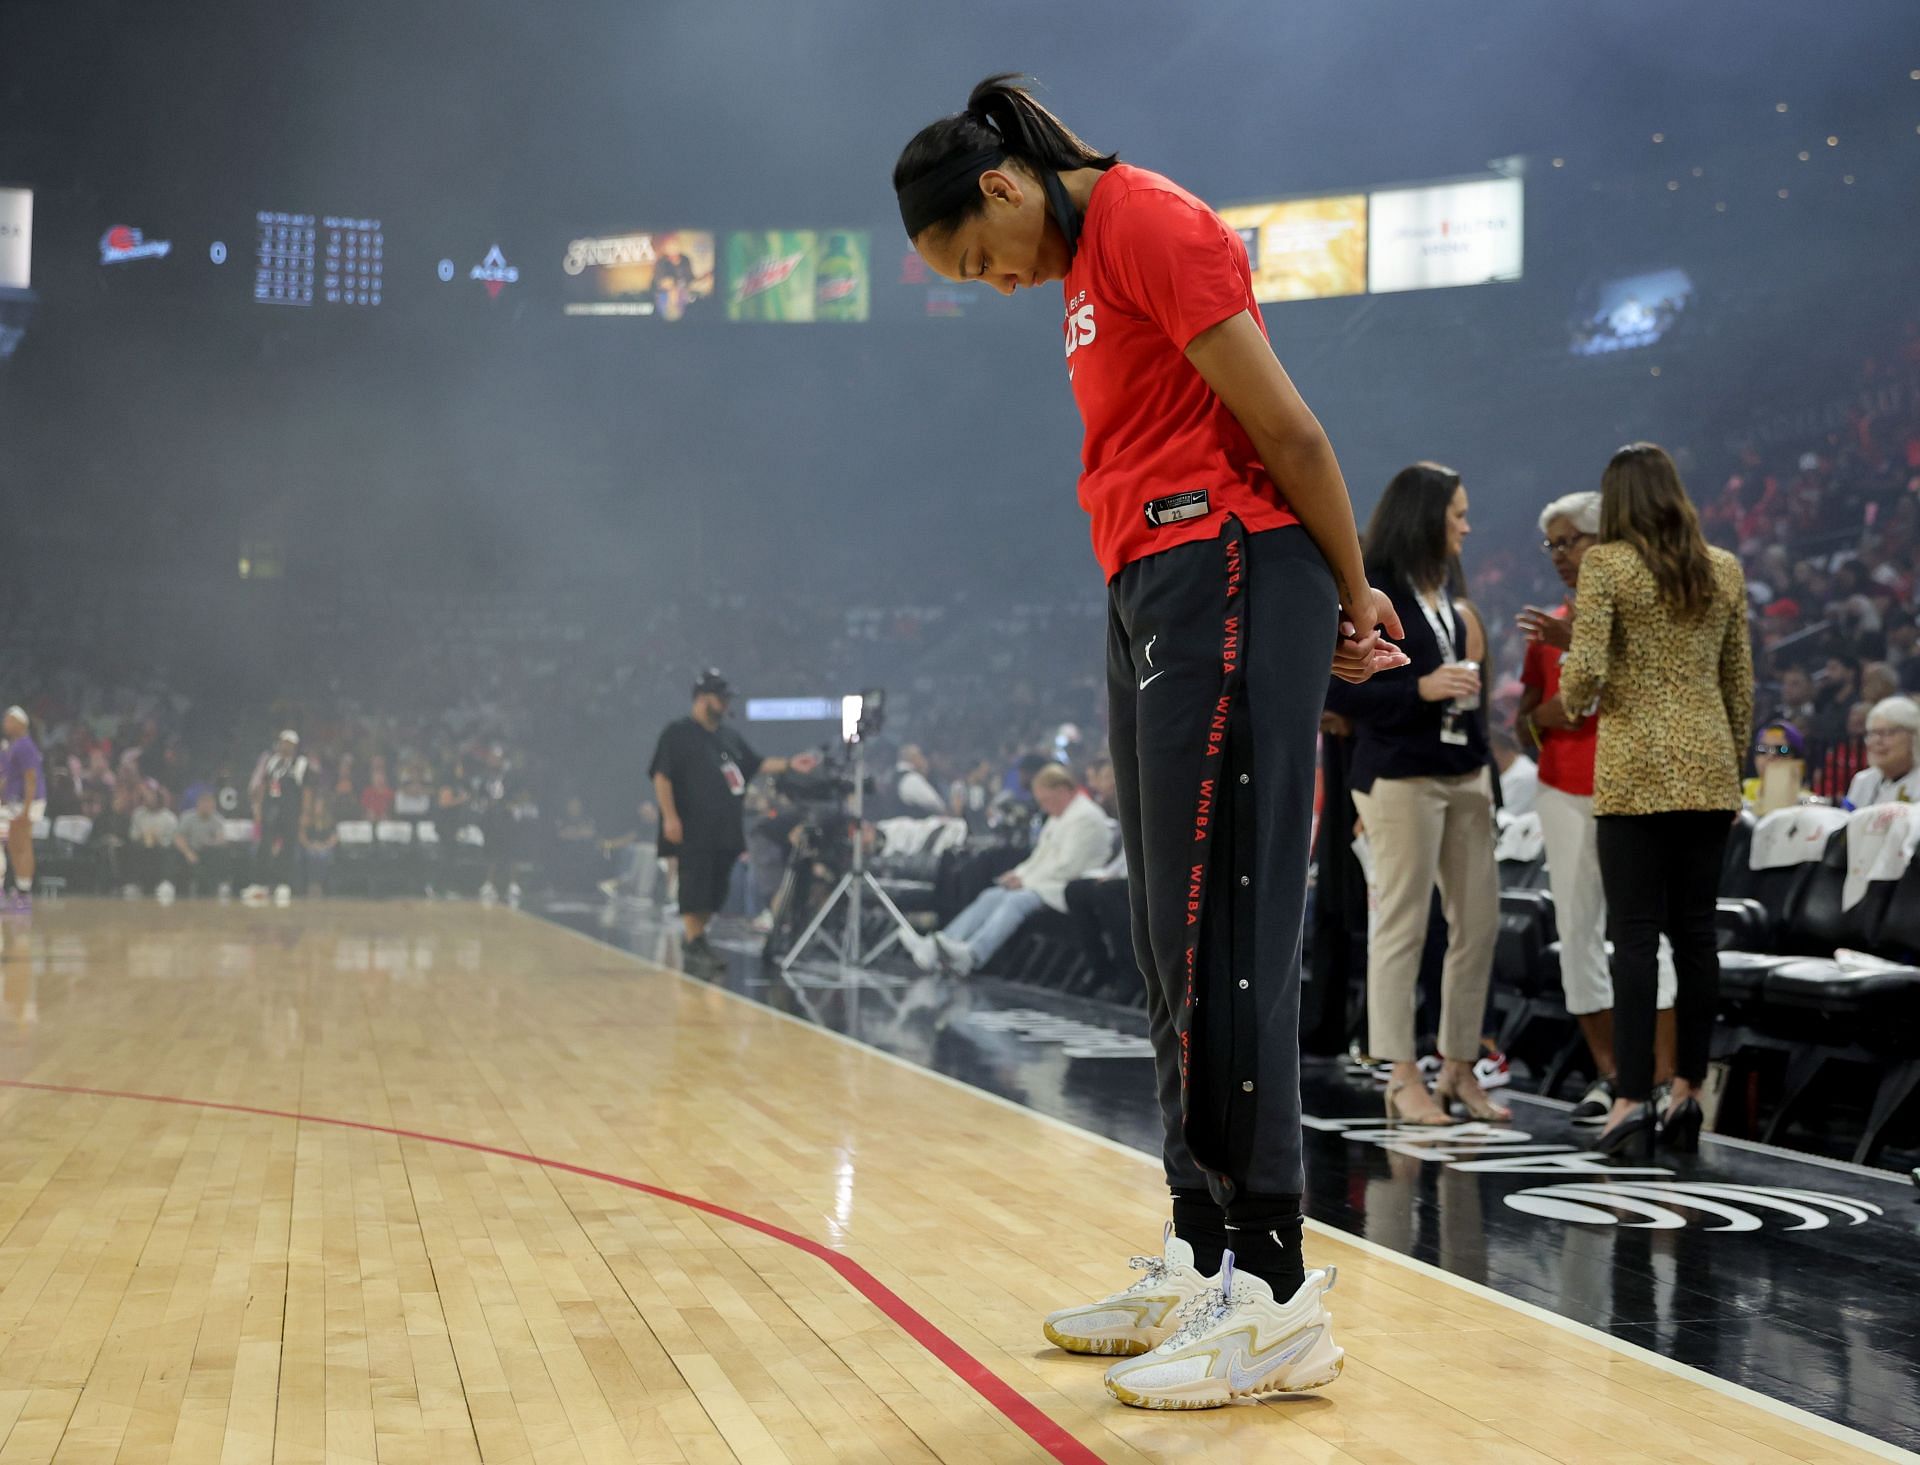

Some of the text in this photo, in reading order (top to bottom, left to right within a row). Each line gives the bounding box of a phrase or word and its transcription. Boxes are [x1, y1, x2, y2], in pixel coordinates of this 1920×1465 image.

[209, 240, 227, 265] 0
[437, 258, 455, 282] 0
[1226, 540, 1241, 598] WNBA
[1223, 616, 1239, 674] WNBA
[1206, 695, 1231, 757] WNBA
[1195, 779, 1214, 841] WNBA
[1186, 863, 1203, 925] WNBA
